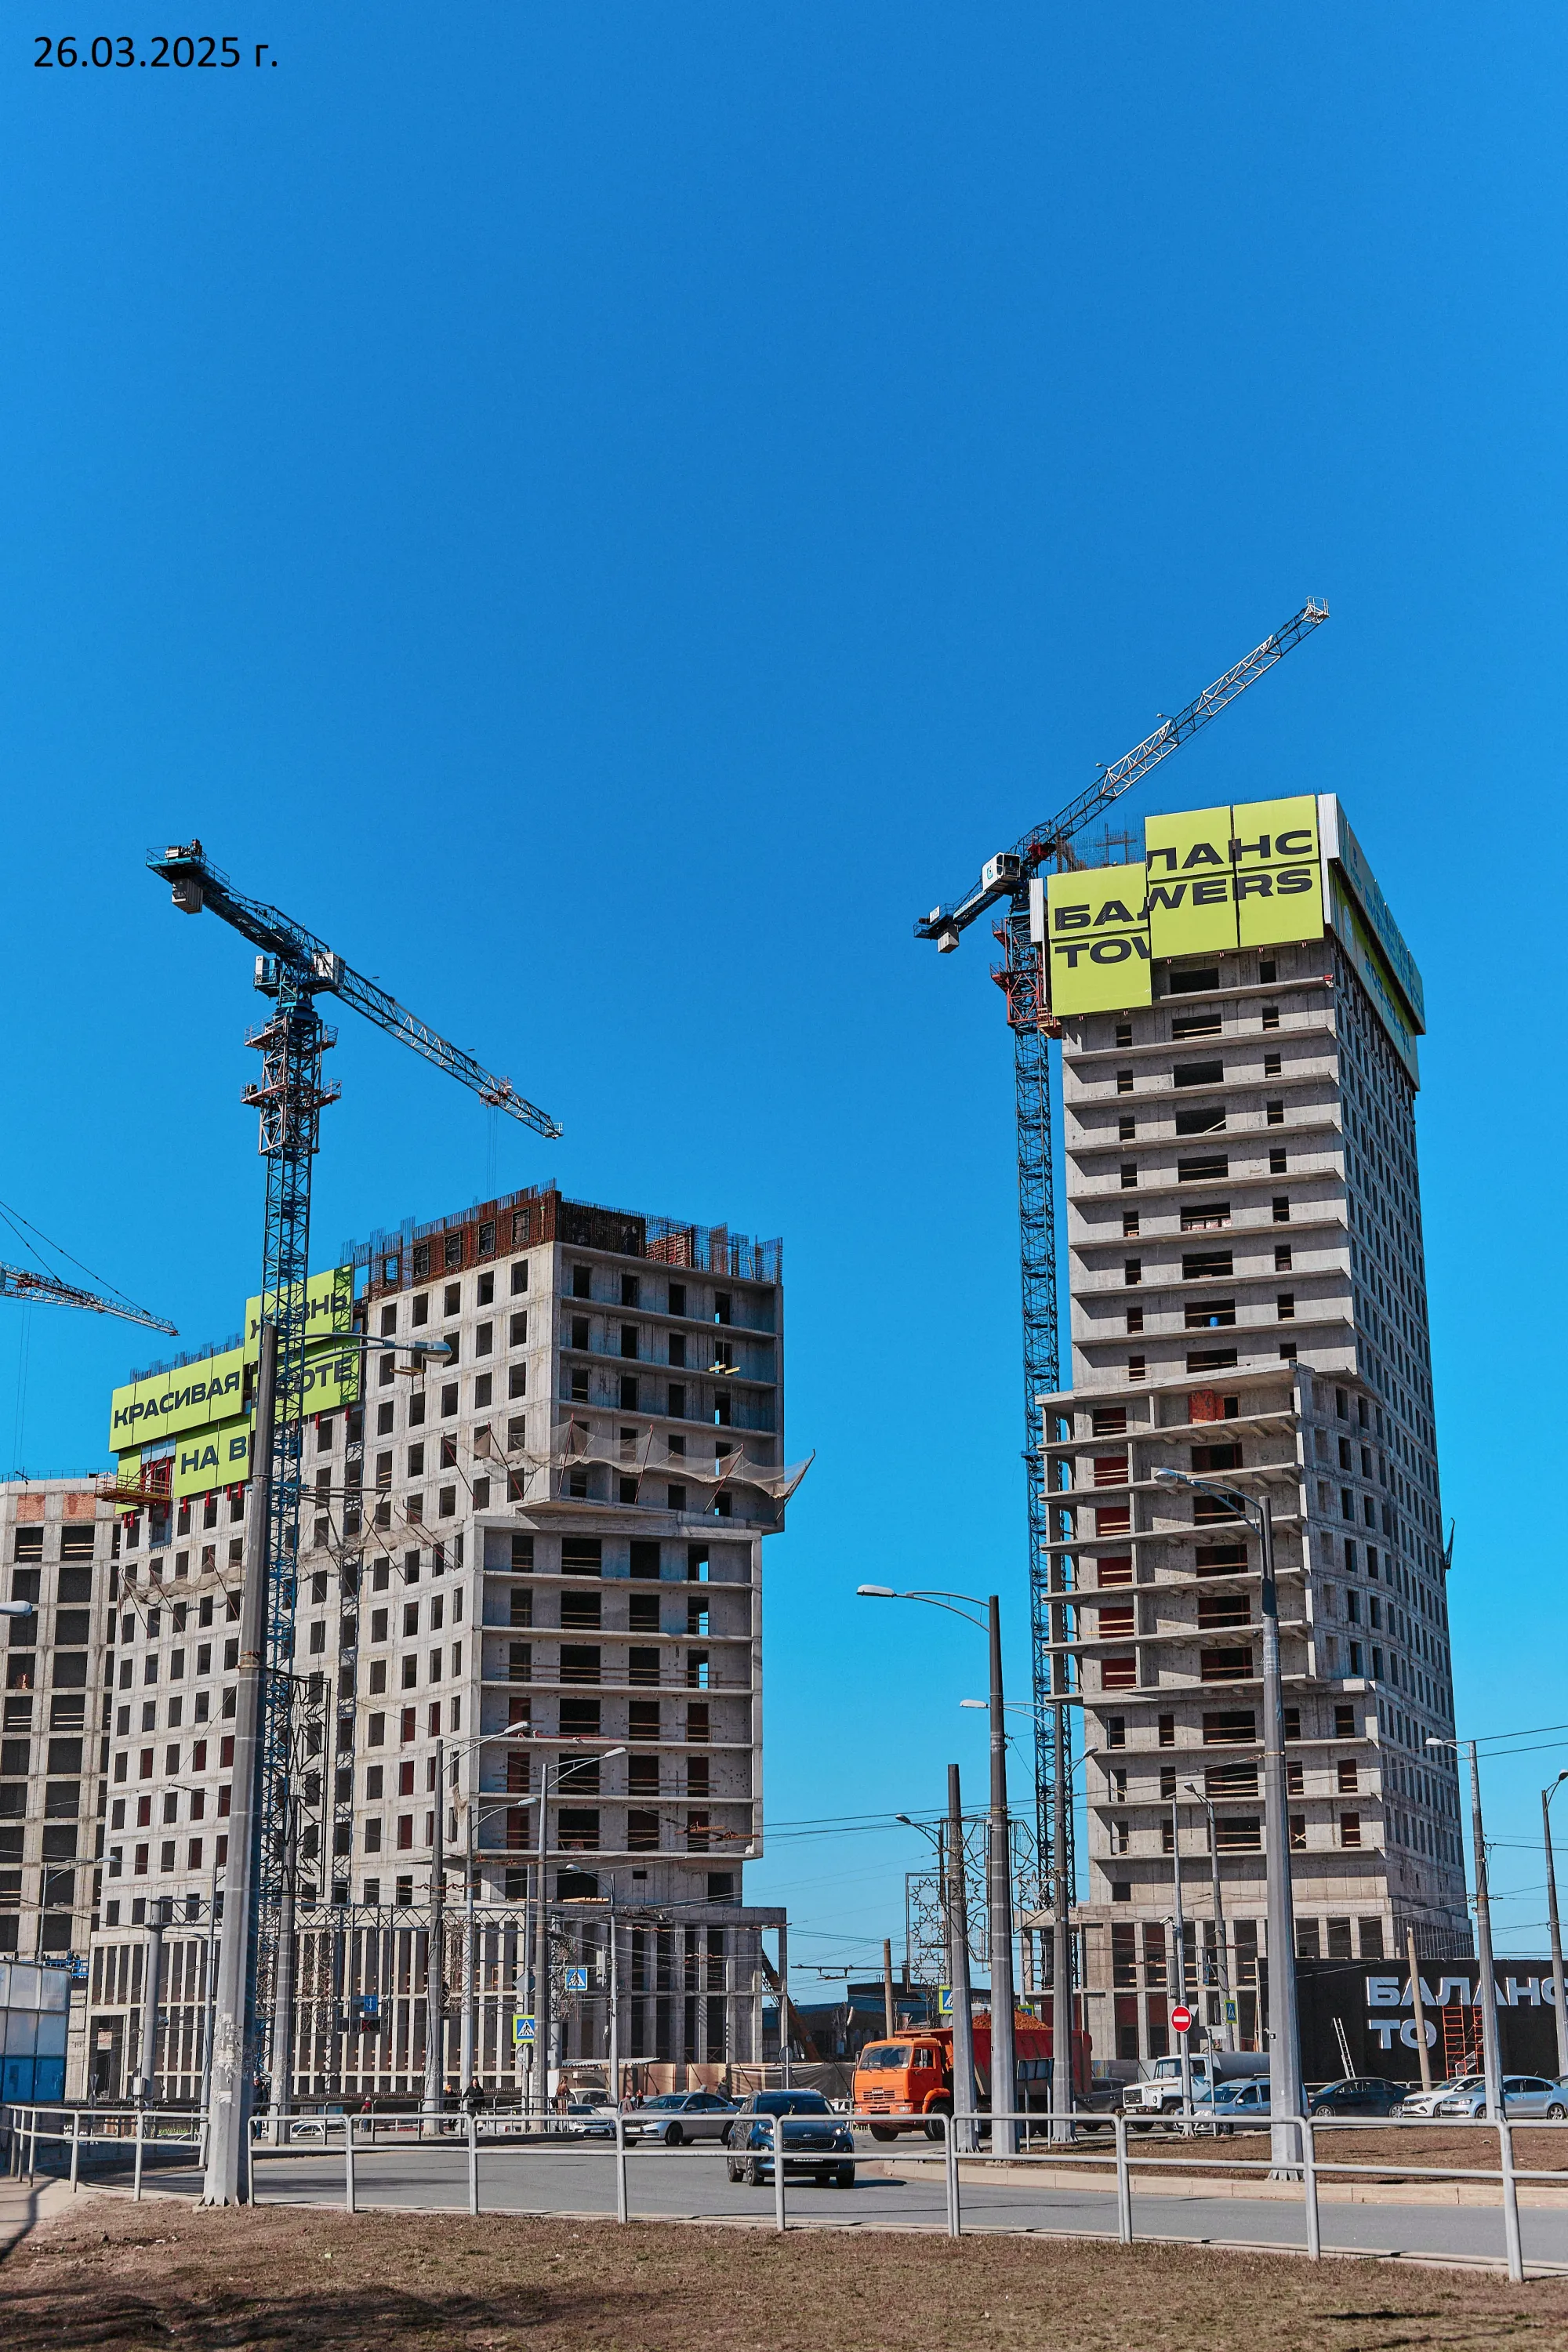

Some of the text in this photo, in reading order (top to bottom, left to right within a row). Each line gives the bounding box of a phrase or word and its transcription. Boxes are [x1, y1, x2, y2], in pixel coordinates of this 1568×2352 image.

[114, 1371, 240, 1428] КРАСИВАЯ
[181, 1446, 220, 1475] НА
[1368, 2019, 1437, 2049] TO
